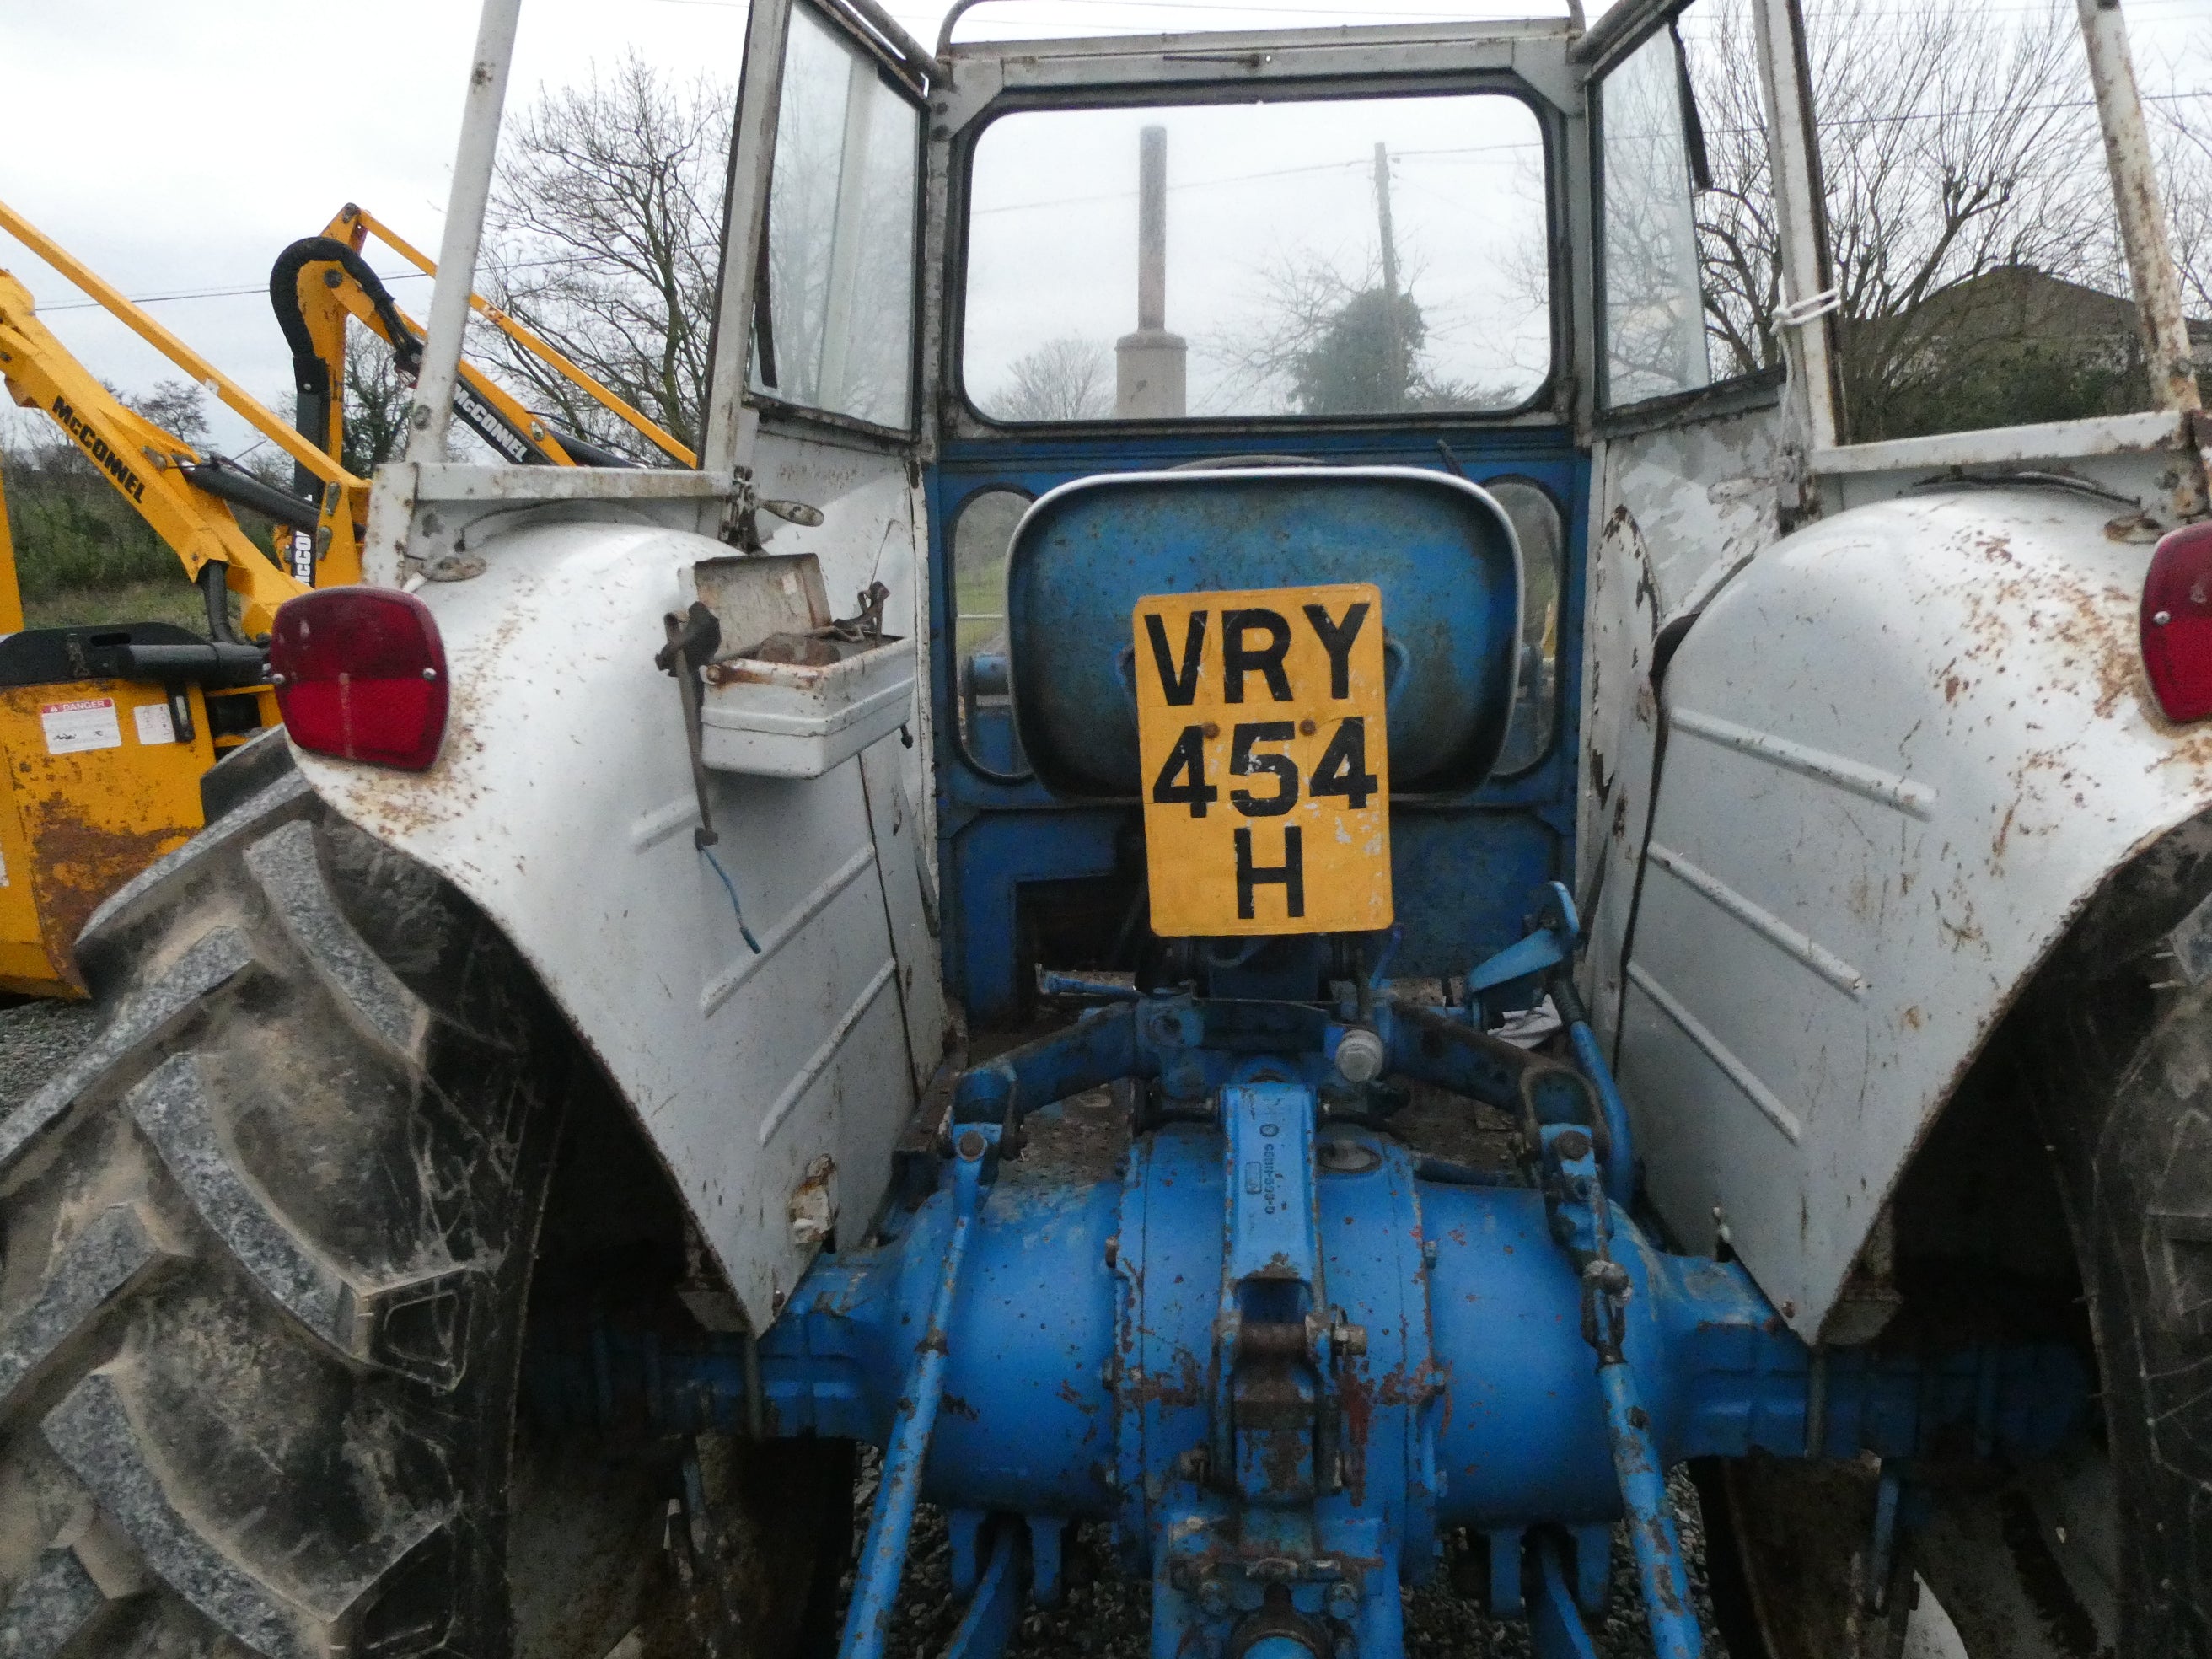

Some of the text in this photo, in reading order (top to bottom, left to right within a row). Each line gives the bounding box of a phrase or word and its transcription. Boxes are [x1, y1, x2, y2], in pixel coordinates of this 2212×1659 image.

[1143, 603, 1371, 706] VRY
[62, 700, 105, 711] DANGER
[1152, 717, 1378, 818] 454
[1234, 825, 1305, 919] H
